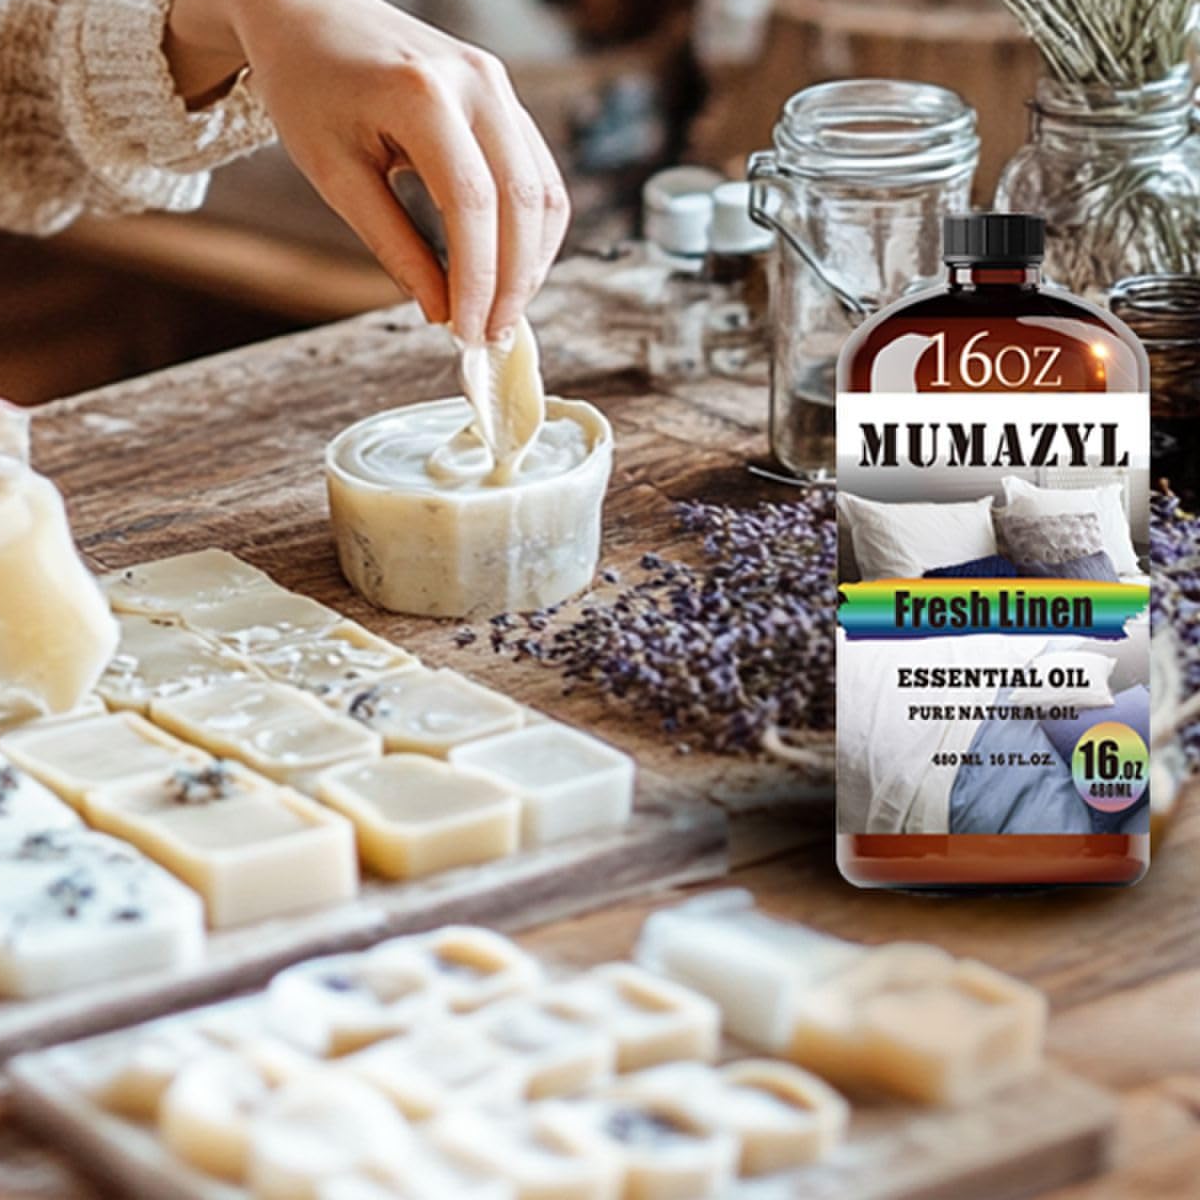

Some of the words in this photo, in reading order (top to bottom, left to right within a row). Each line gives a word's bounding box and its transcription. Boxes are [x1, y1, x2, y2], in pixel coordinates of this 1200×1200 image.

[858, 423, 1130, 468] MUMAZYL
[894, 590, 990, 628] Fresh
[999, 590, 1093, 628] Linen
[897, 668, 1042, 688] ESSENTIAL
[1047, 668, 1090, 688] OIL
[908, 705, 955, 721] PURE
[958, 705, 1046, 721] NATURAL
[1047, 705, 1079, 721] OIL
[931, 752, 958, 766] 480
[960, 752, 984, 766] ML
[989, 752, 1006, 766] 16
